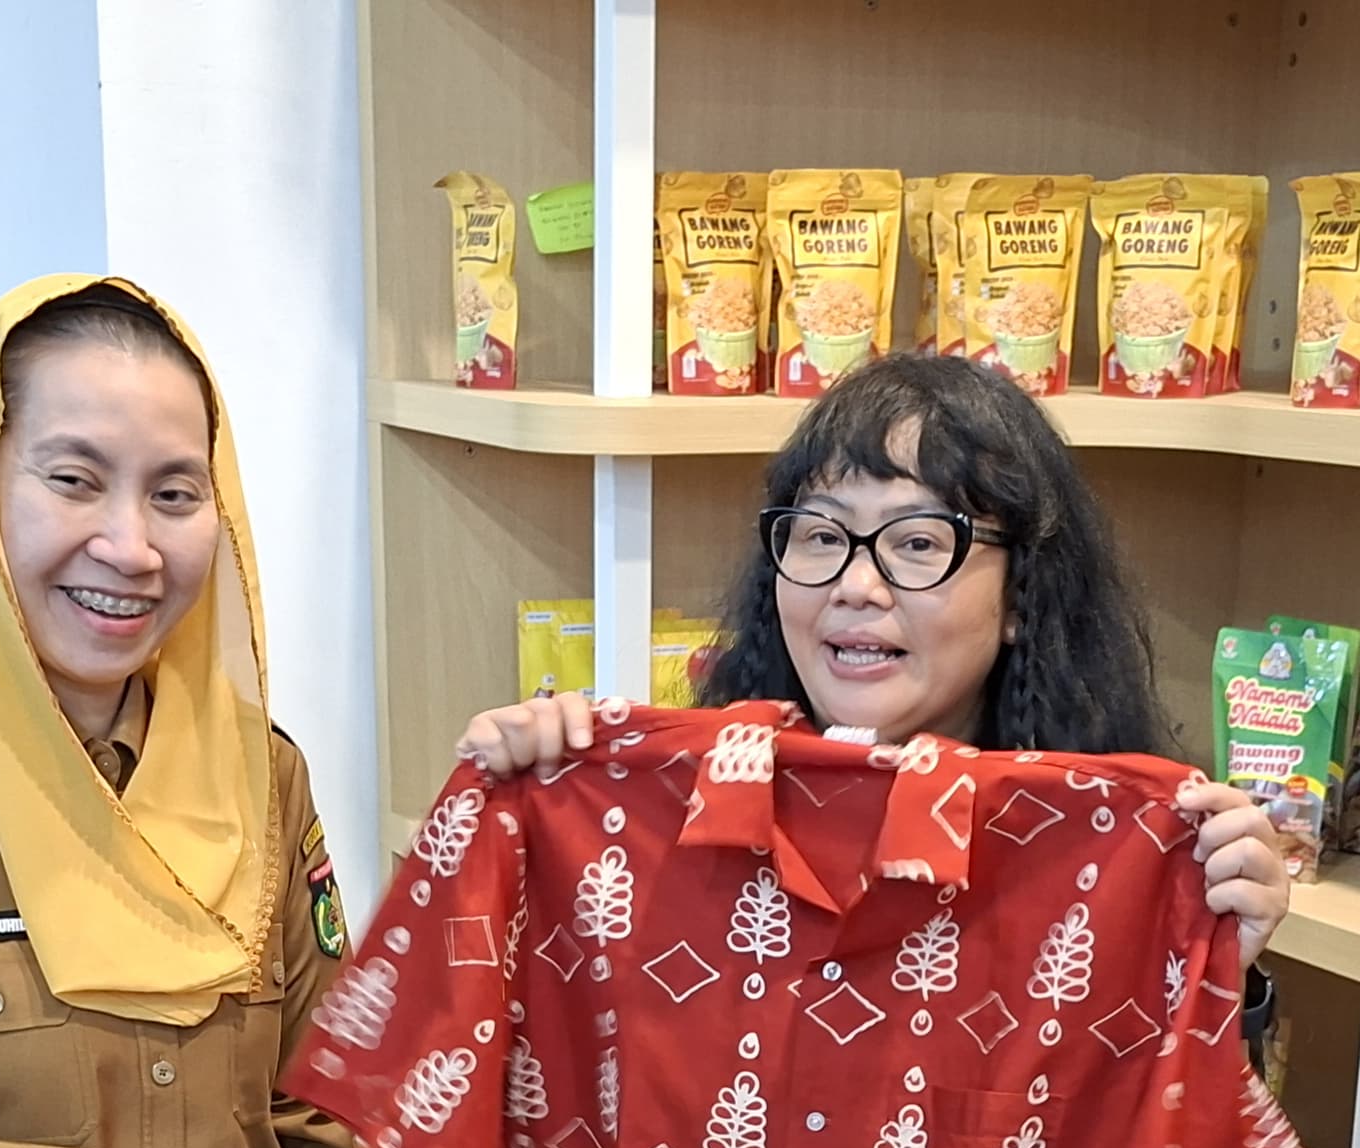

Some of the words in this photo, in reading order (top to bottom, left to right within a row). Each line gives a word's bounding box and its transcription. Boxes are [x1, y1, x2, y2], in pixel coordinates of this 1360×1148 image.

[687, 217, 750, 232] BAWANG
[798, 219, 869, 235] BAWANG
[994, 219, 1058, 235] BAWANG
[1121, 219, 1193, 235] BAWANG
[696, 234, 753, 250] GORENG
[803, 239, 868, 254] GORENG
[999, 239, 1058, 255] GORENG
[1121, 239, 1189, 254] GORENG
[1226, 678, 1314, 709] Namomi
[1228, 703, 1302, 732] Nalala
